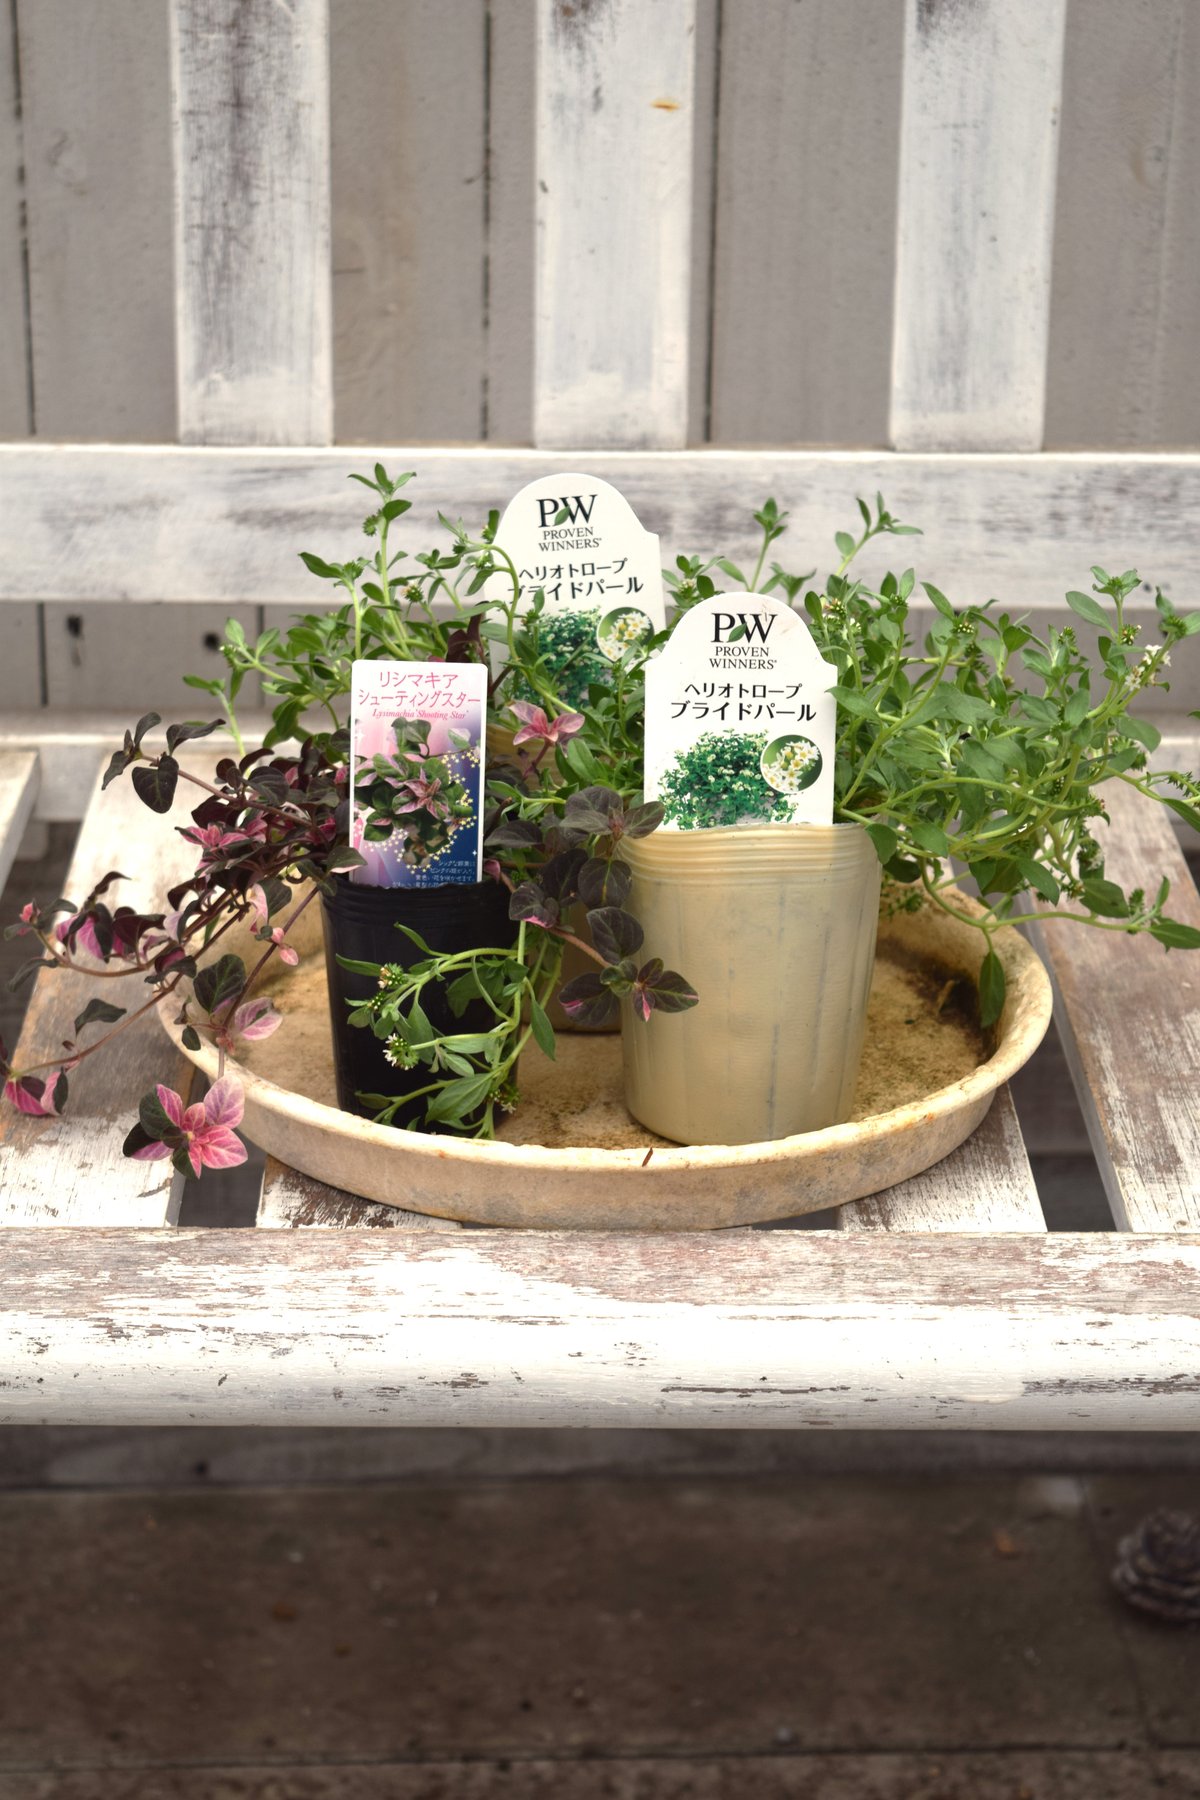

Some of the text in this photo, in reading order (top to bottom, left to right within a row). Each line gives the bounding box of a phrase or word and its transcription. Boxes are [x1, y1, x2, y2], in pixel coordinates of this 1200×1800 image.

[543, 527, 594, 541] PROVEN
[518, 557, 628, 581] ヘリオトロープ
[710, 612, 778, 643] PW
[715, 646, 770, 657] PROVEN
[380, 671, 459, 689] リシマキア
[358, 689, 481, 709] シューティングスター
[684, 682, 803, 700] ヘリオトロープ
[671, 700, 817, 722] ブライドパール
